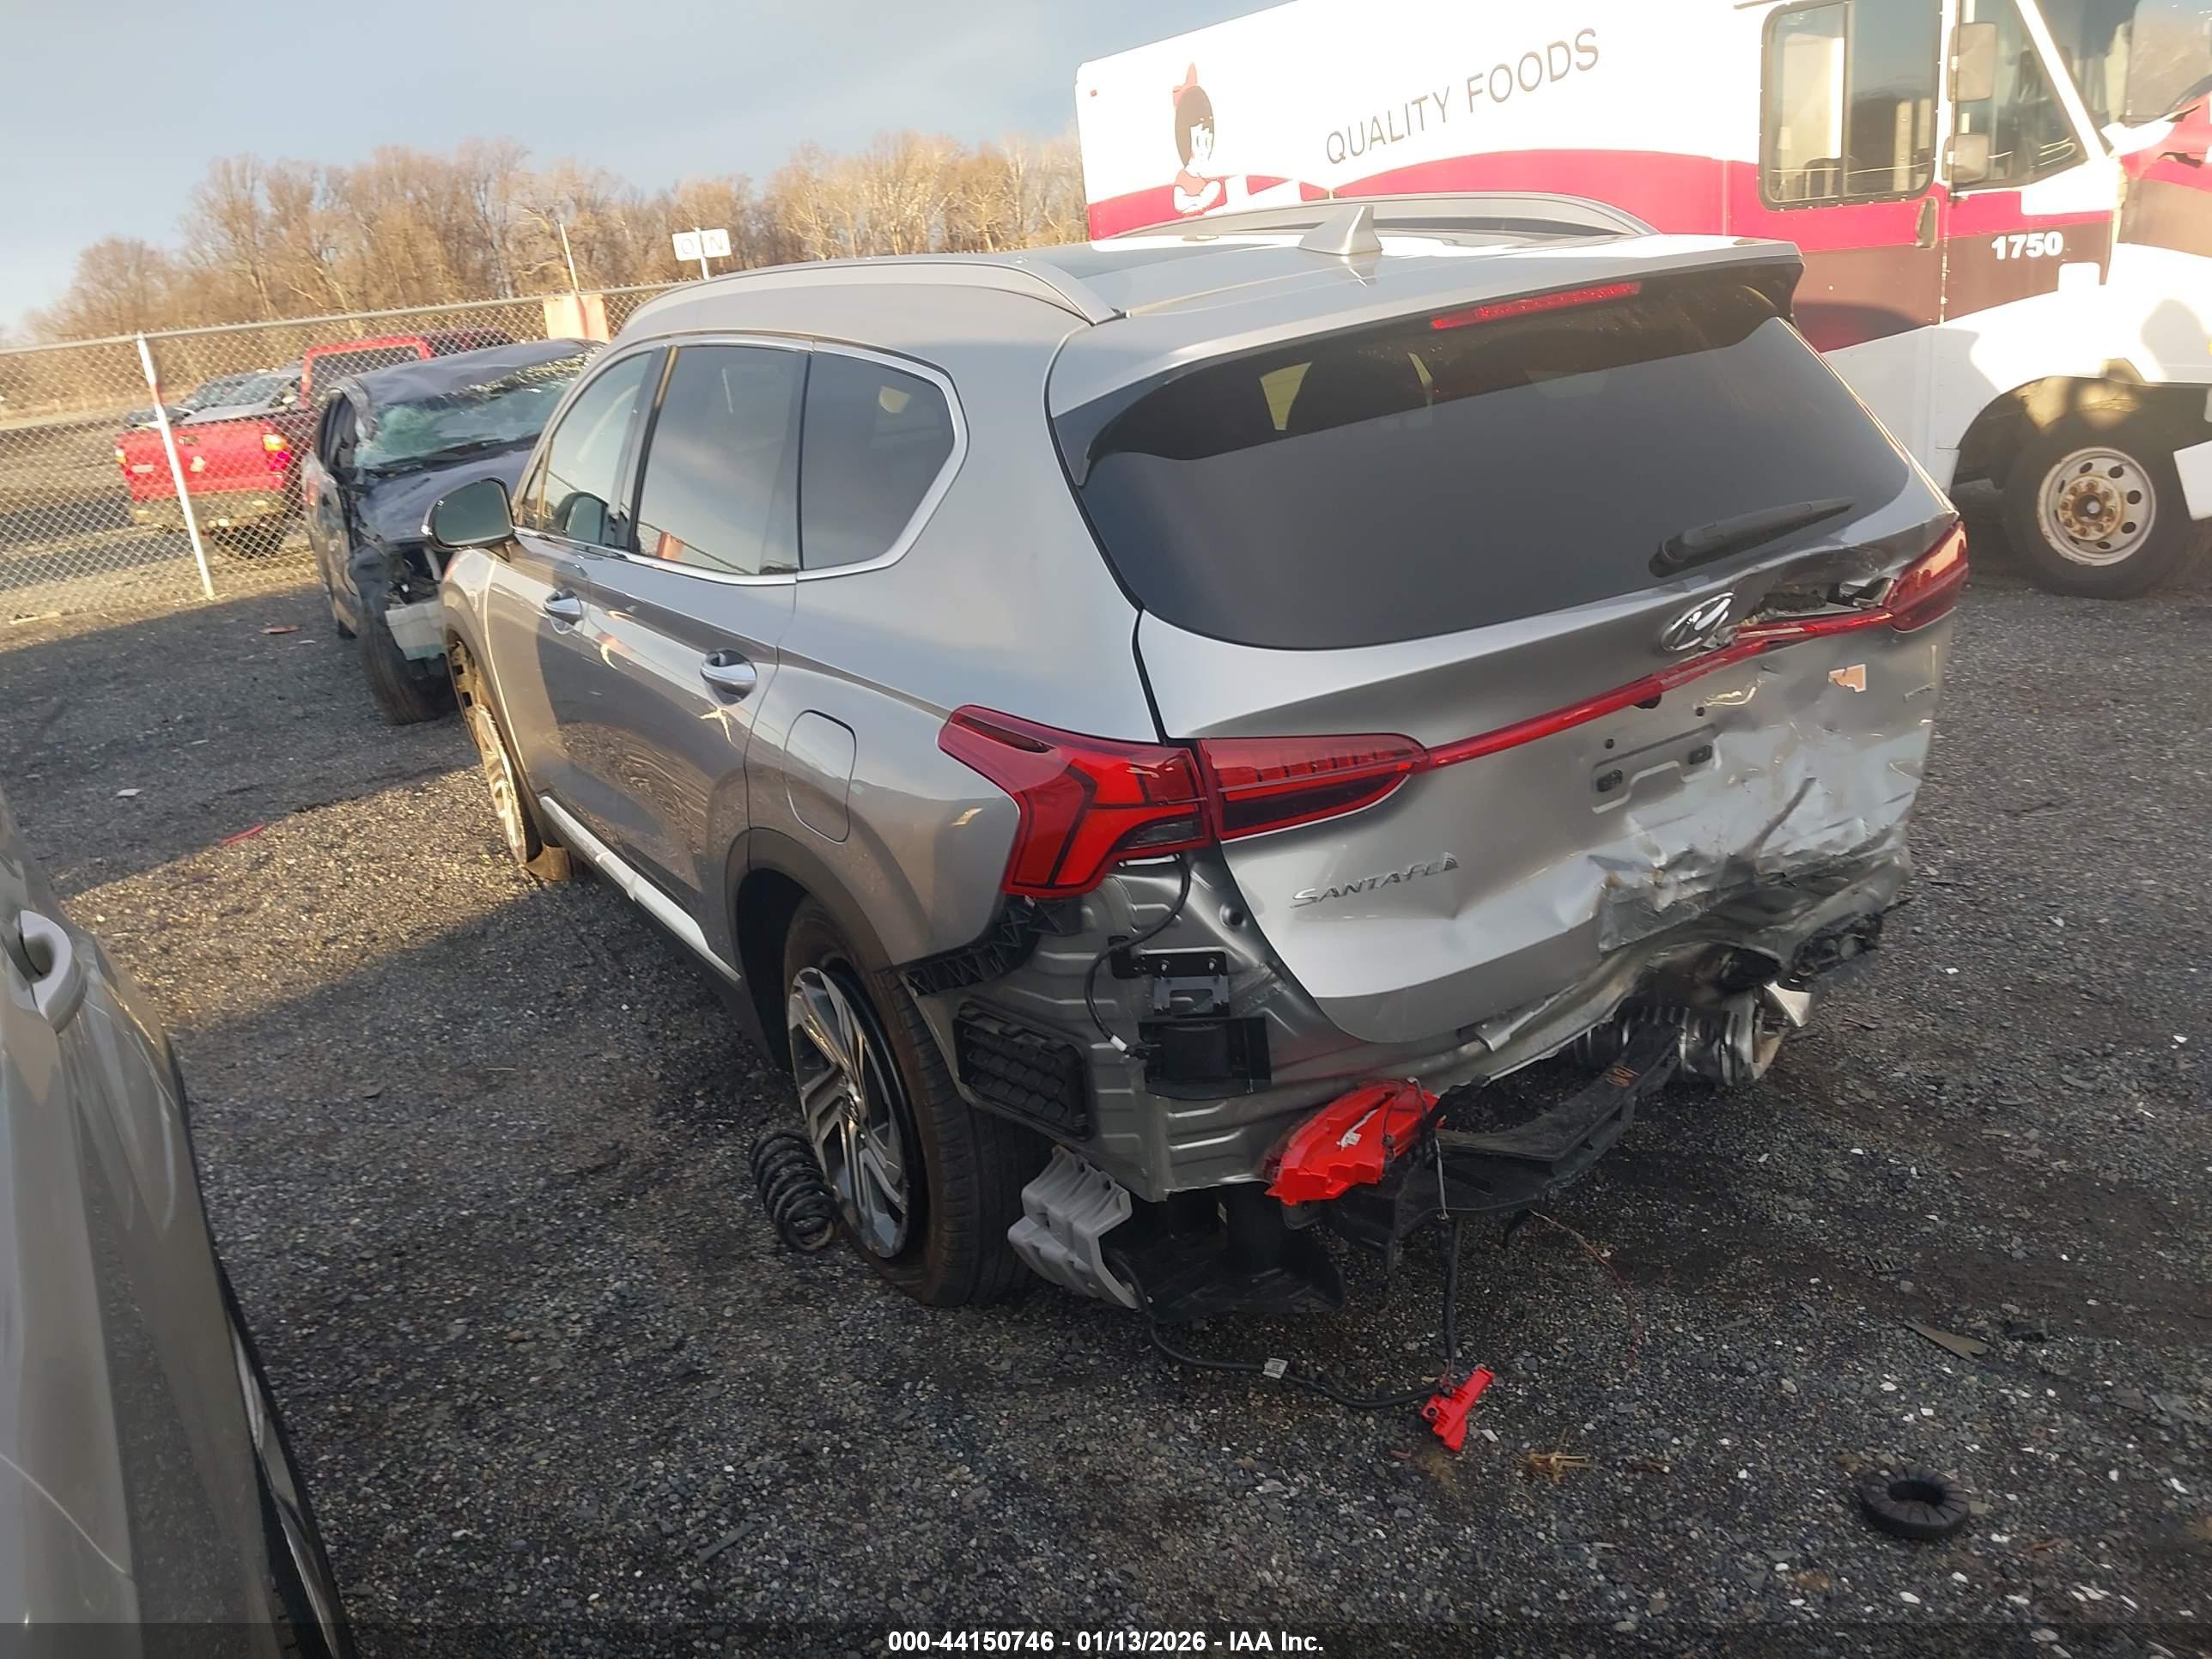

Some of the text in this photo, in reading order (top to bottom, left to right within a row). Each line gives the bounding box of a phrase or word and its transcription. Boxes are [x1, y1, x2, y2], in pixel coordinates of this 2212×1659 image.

[1327, 27, 1599, 165] QUALITY FOODS
[1991, 230, 2063, 260] 1750
